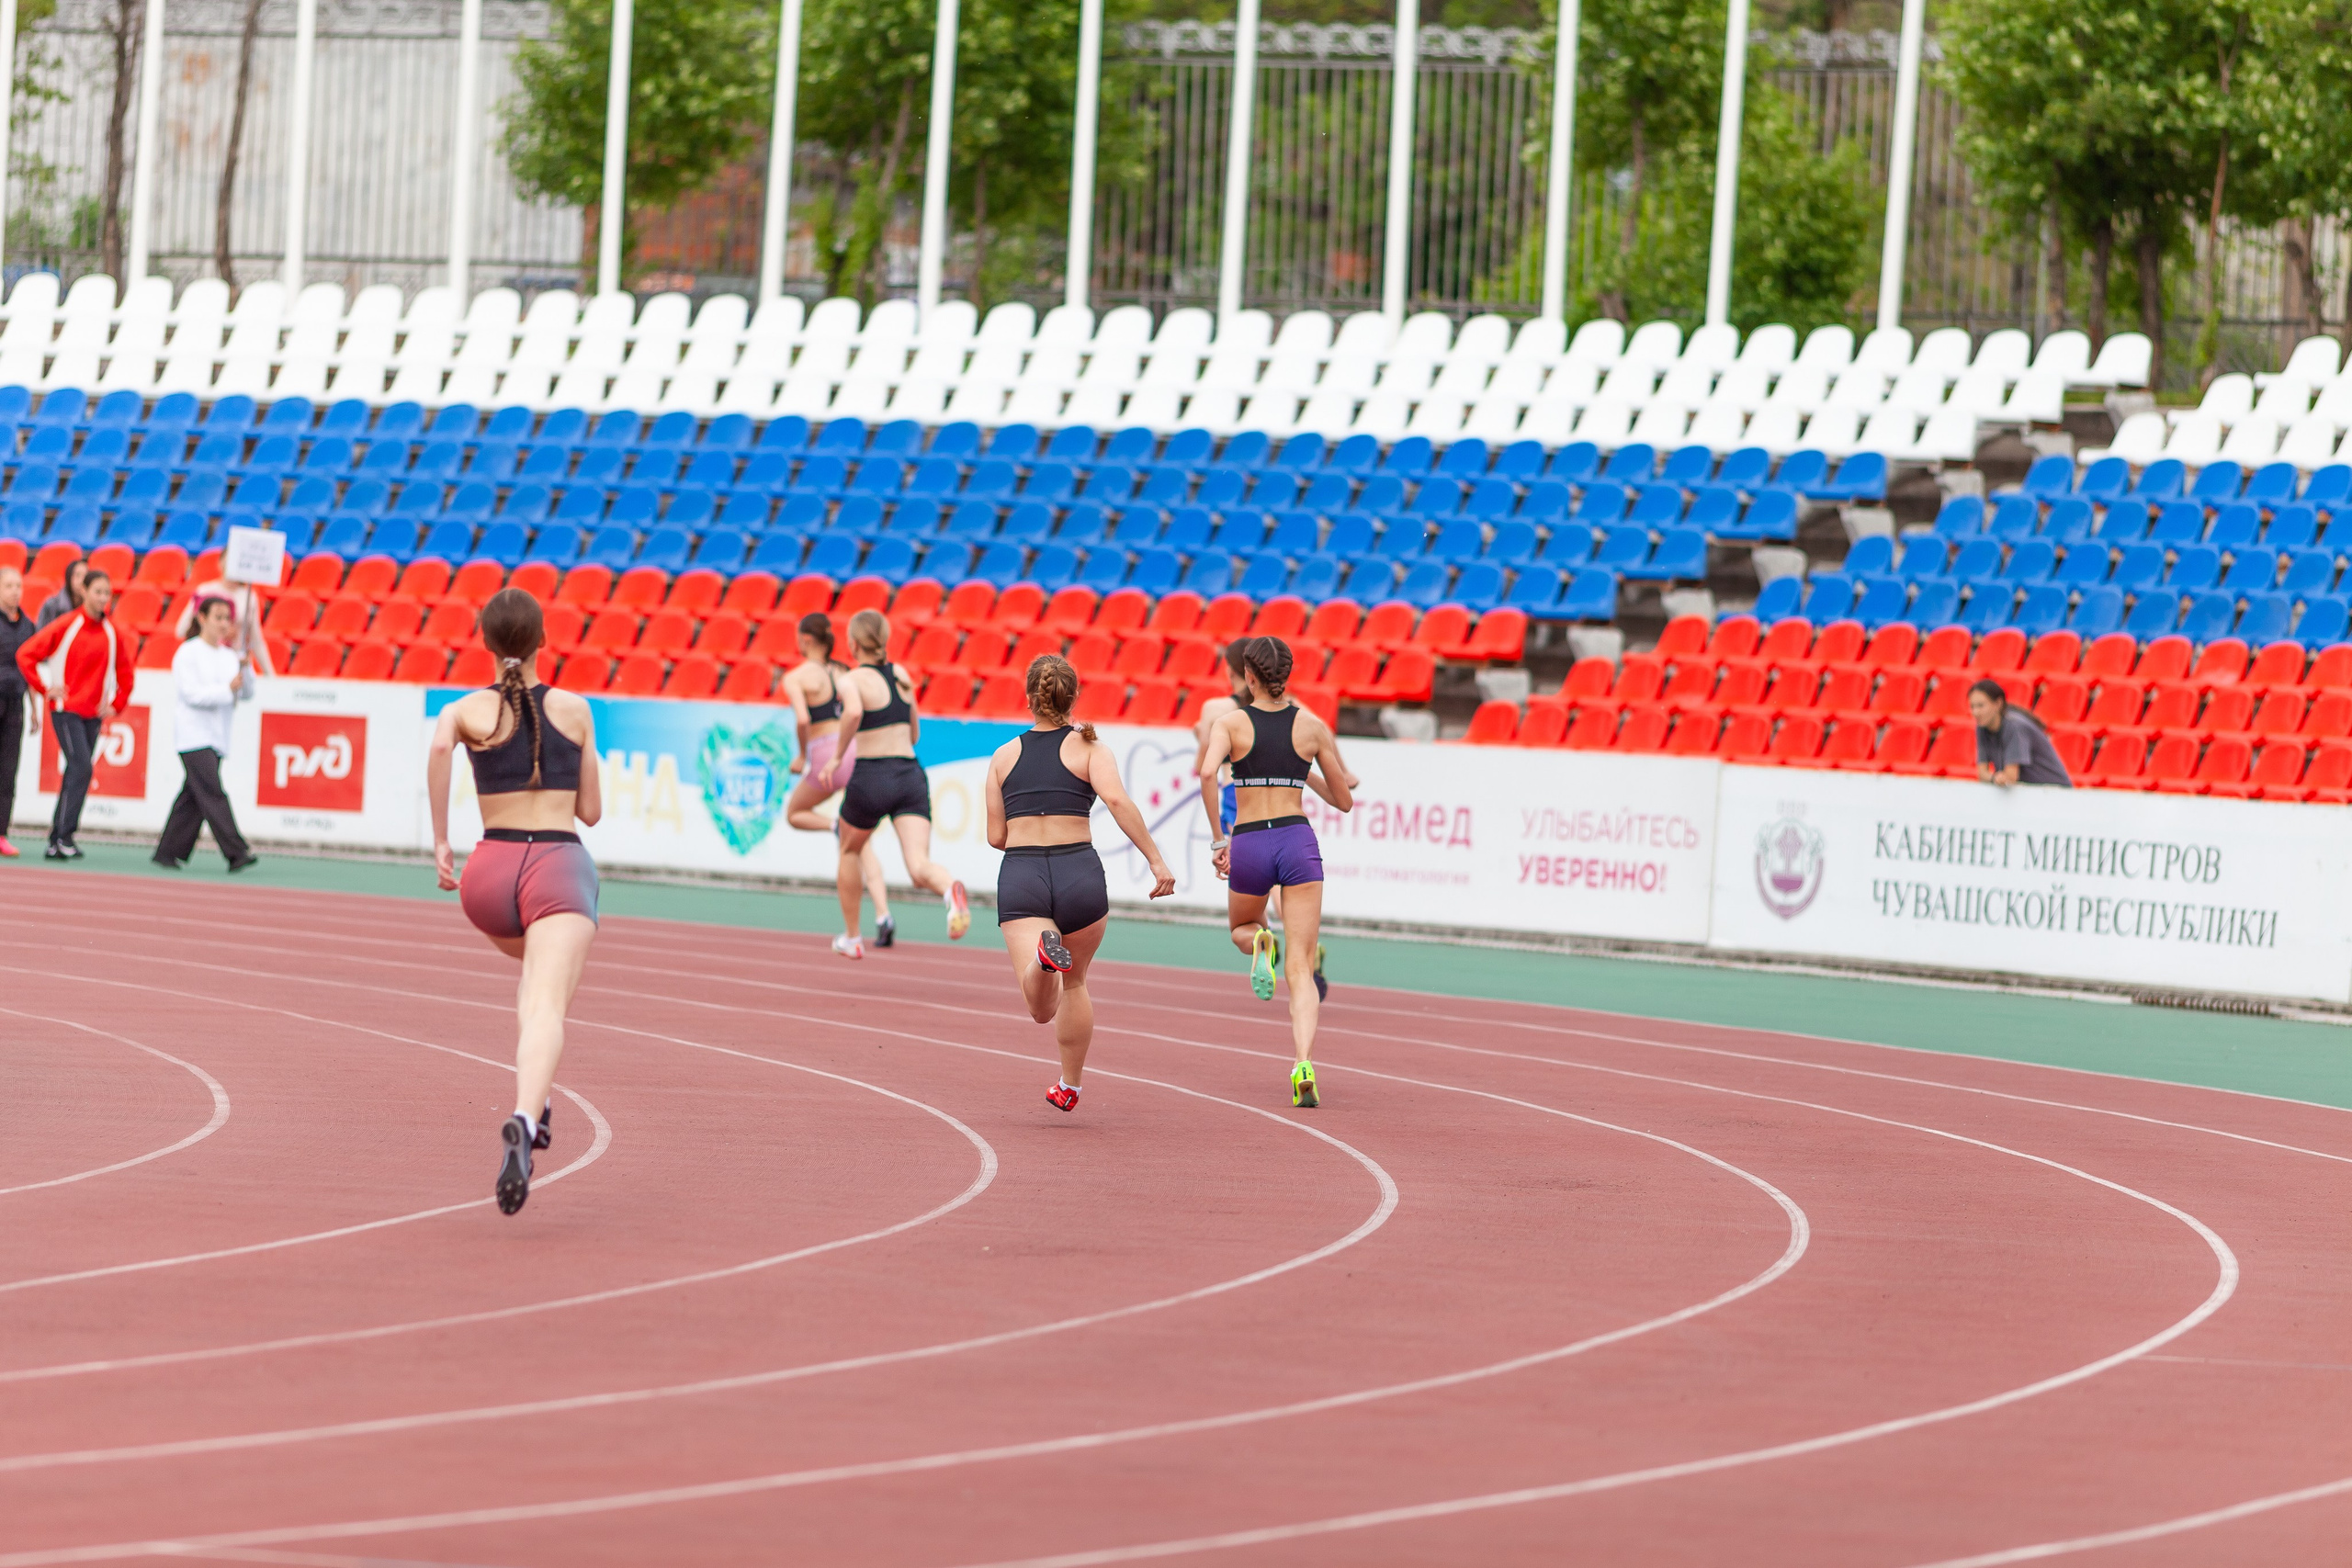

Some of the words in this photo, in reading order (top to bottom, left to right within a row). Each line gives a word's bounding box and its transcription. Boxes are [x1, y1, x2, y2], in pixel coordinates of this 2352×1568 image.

[1245, 778, 1267, 786] PUMA
[1269, 778, 1291, 786] PUMA
[1301, 797, 1473, 849] ентамед
[1521, 806, 1700, 849] УЛЫБАЙТЕСЬ
[1518, 852, 1668, 894] УВЕРЕННО!
[1874, 821, 2017, 869] КАБИНЕТ
[2024, 832, 2222, 884] МИНИСТРОВ
[1871, 879, 2066, 932] ЧУВАШСКОЙ
[2076, 895, 2278, 949] РЕСПУБЛИКИ
